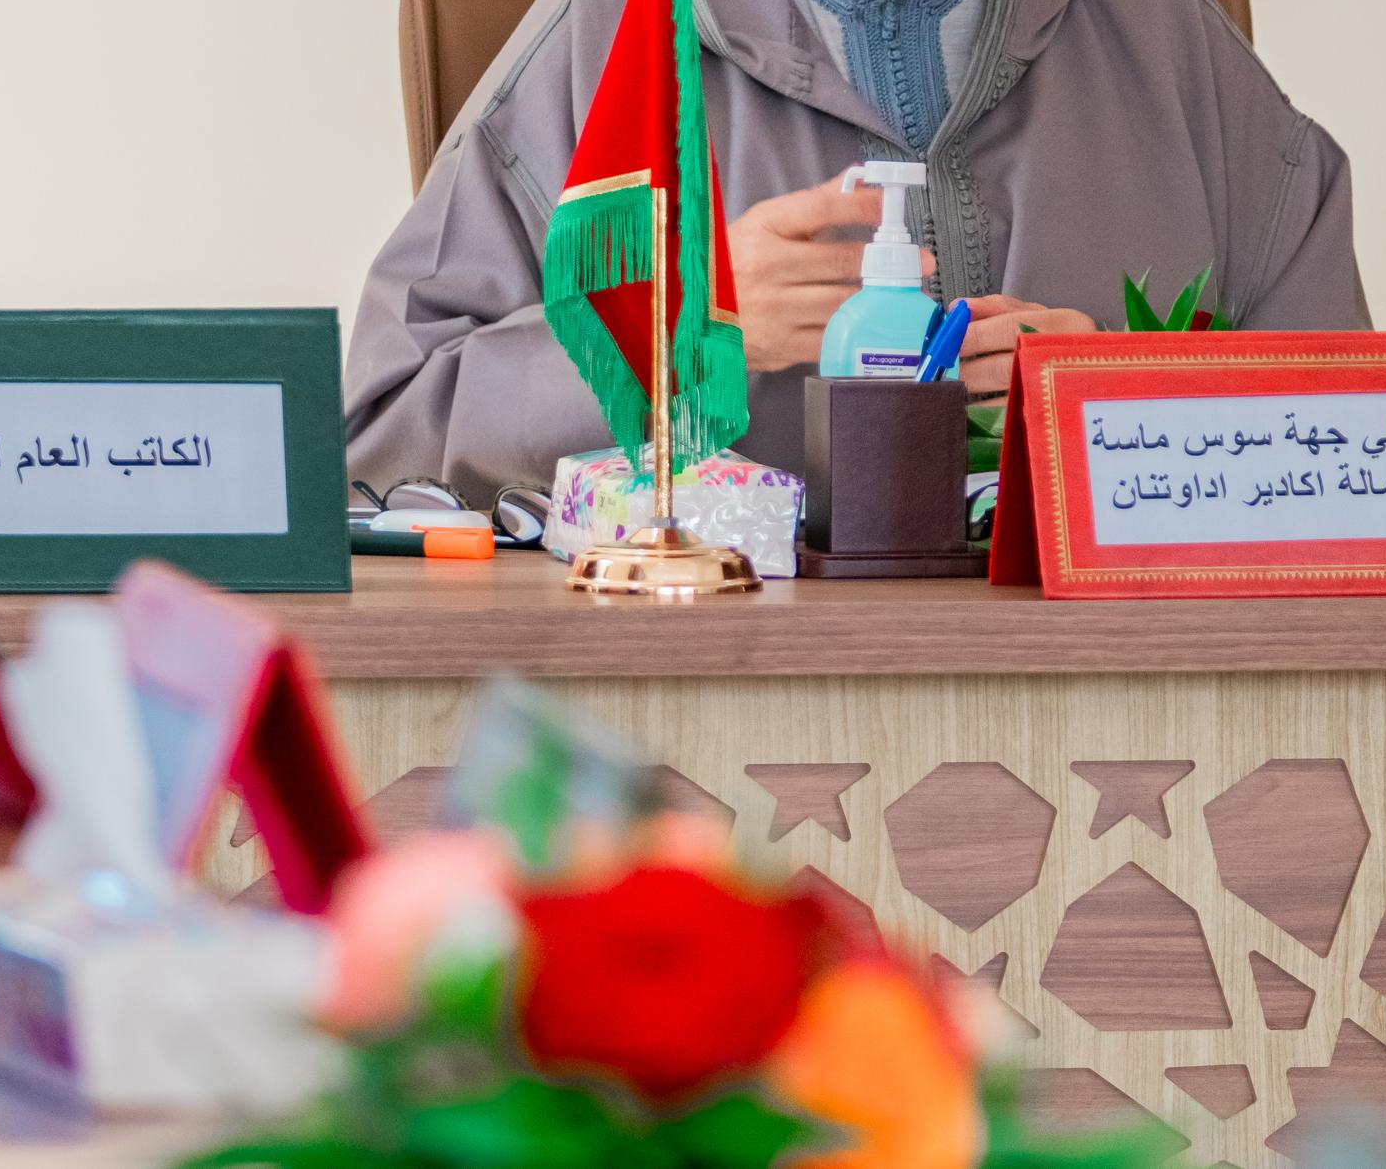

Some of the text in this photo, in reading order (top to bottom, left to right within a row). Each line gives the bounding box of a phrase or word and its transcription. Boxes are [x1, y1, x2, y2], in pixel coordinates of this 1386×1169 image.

[1091, 417, 1170, 451] ماسة
[1183, 430, 1273, 457] سوس
[1284, 412, 1349, 459] جهة
[16, 434, 90, 484] العام
[107, 434, 212, 477] الكاتب
[1112, 472, 1227, 510] اداوتنان
[1242, 471, 1324, 507] اكادير
